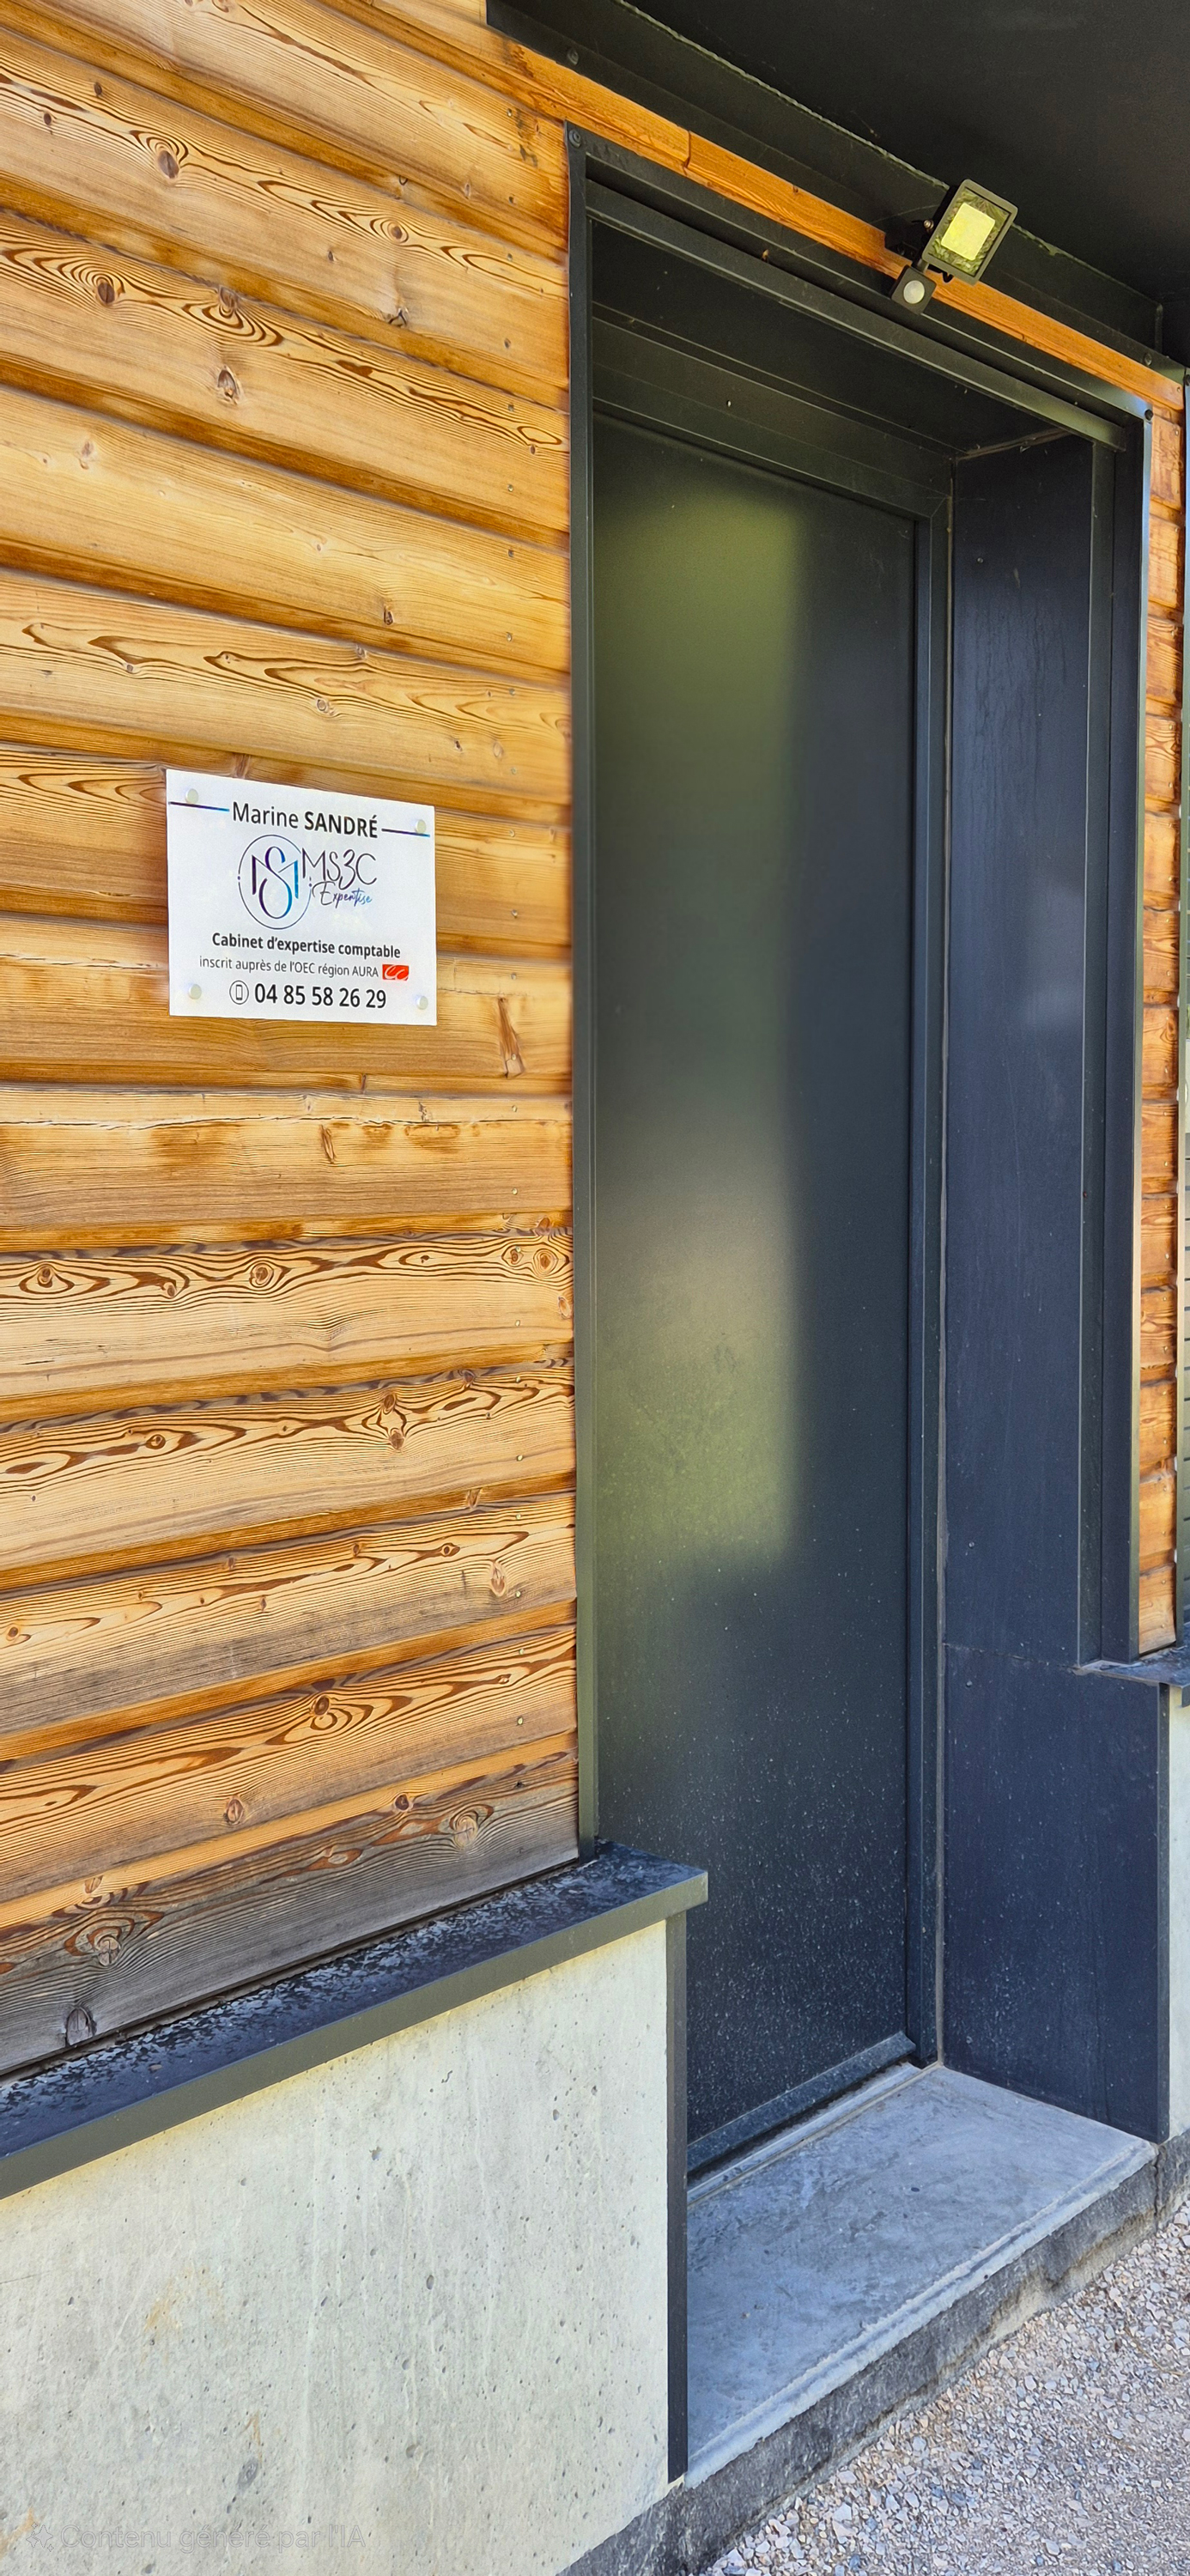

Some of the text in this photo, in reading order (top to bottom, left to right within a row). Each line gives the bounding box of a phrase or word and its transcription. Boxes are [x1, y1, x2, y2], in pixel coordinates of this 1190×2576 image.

[233, 801, 378, 839] Marine SANDRÉ
[301, 847, 377, 890] MS3C
[312, 881, 373, 908] Expertise
[212, 933, 264, 950] Cabinet
[337, 945, 401, 959] comptable
[199, 956, 233, 969] inscrit
[235, 958, 271, 974] auprès
[274, 960, 287, 973] de
[318, 963, 350, 979] région
[351, 965, 379, 978] AURA
[254, 983, 386, 1009] 04 85 58 26 29
